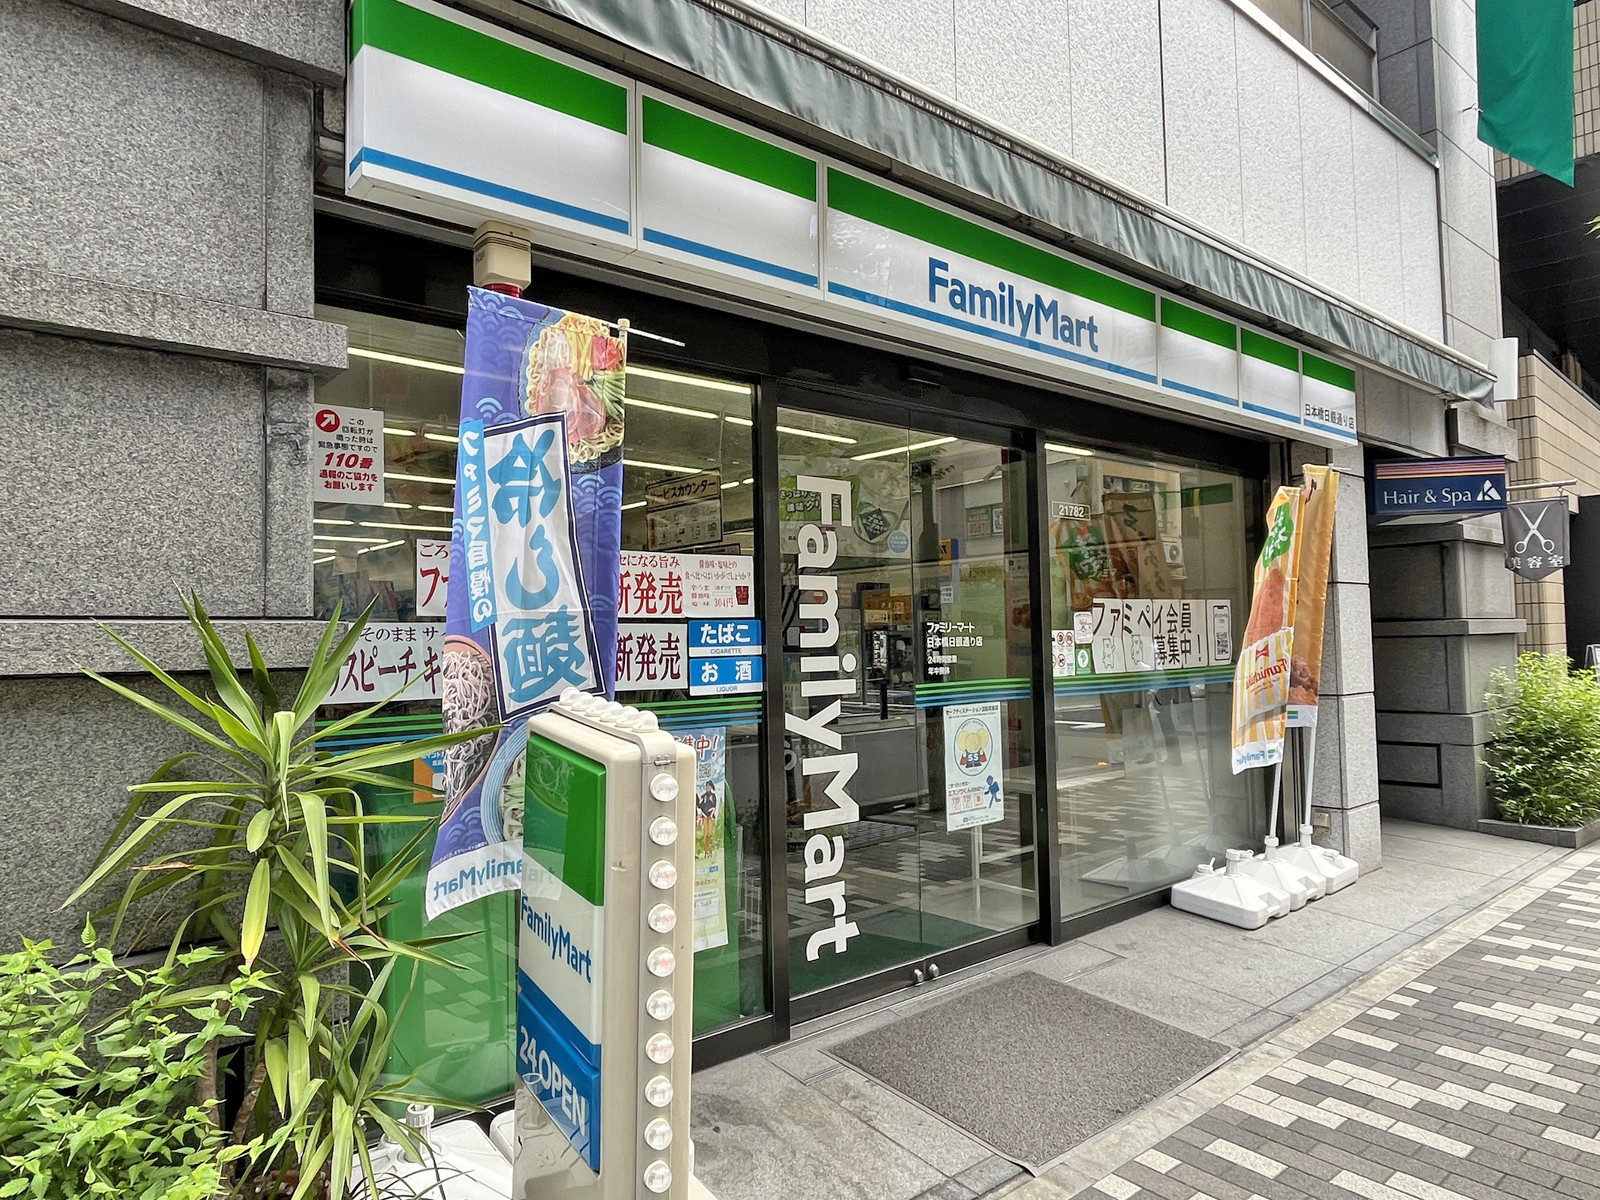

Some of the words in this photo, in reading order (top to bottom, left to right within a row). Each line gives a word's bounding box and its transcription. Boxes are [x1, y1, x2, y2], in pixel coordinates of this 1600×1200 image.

[928, 257, 1099, 352] FamilyMart
[348, 418, 364, 426] この
[324, 452, 374, 469] 110番
[319, 469, 378, 482] 通報のご協力を
[324, 481, 374, 492] お願いします
[650, 479, 717, 502] ービスカウンター
[1384, 490, 1419, 505] Hair
[1424, 490, 1437, 504] &
[1444, 487, 1472, 506] Spa
[1058, 505, 1085, 518] 21782
[1511, 553, 1564, 570] 美容室
[926, 622, 975, 634] ファミリーマート
[1093, 603, 1192, 636] ファミペイ会員
[358, 626, 417, 643] そのまま
[422, 626, 447, 642] サ
[700, 623, 751, 645] たばこ
[614, 632, 681, 683] 新発売
[710, 647, 742, 655] CIGARETTE
[1154, 634, 1202, 665] 募集中!
[329, 645, 446, 697] スピーチキ
[715, 685, 739, 693] LIQUOR
[784, 474, 861, 963] FamilyMart
[674, 734, 720, 760] 中!
[521, 895, 592, 984] FamilyMart
